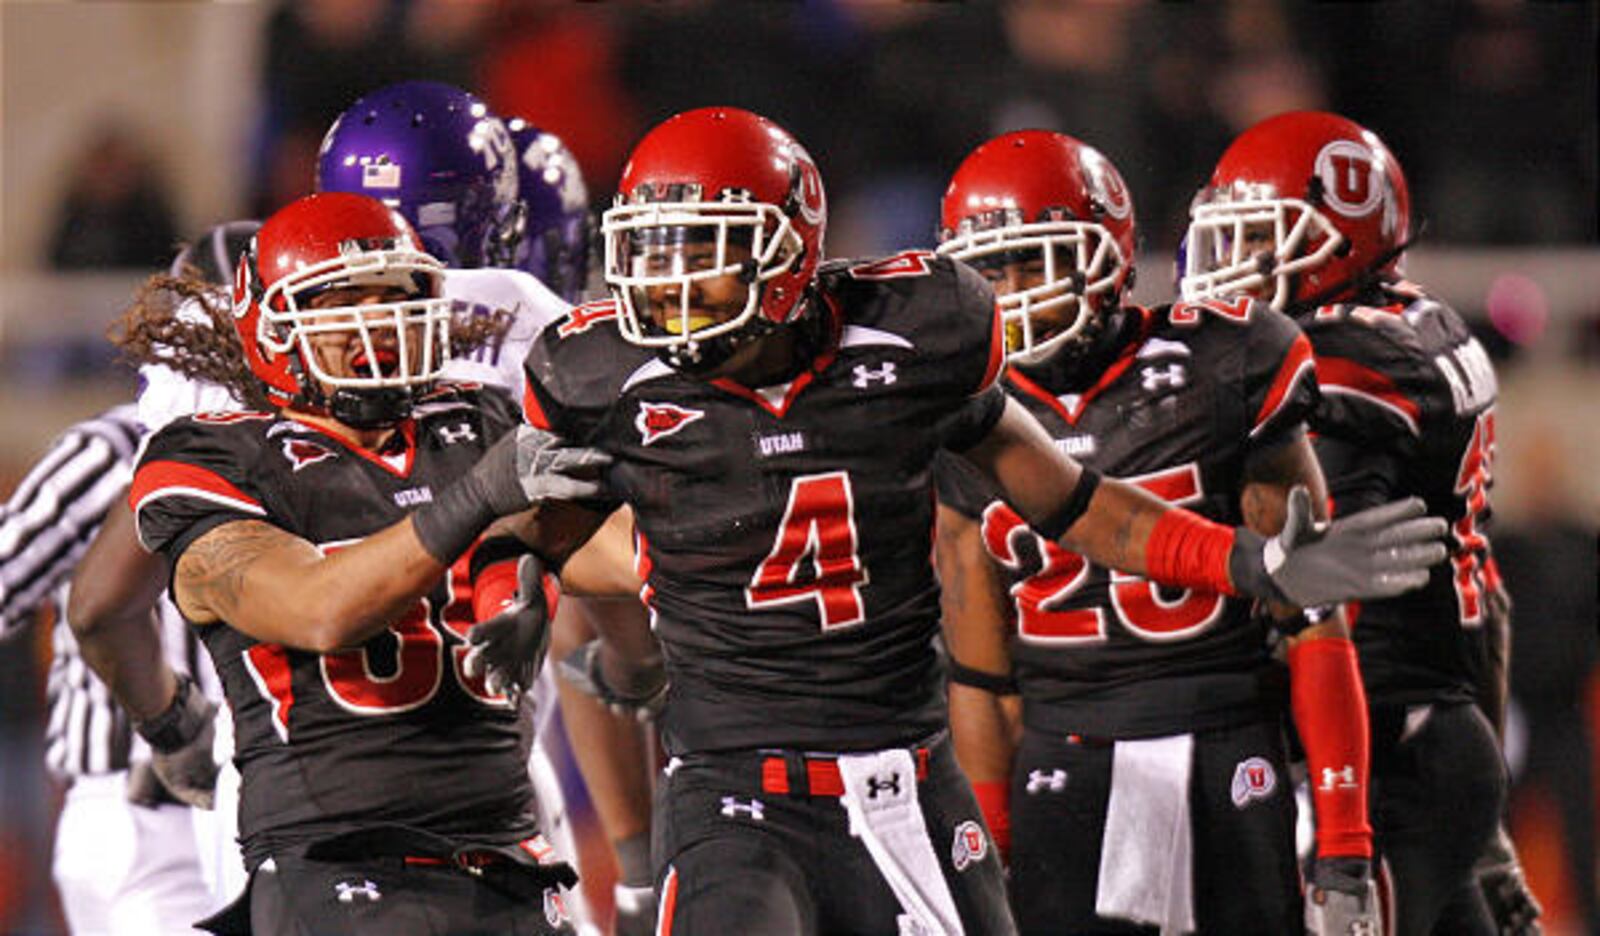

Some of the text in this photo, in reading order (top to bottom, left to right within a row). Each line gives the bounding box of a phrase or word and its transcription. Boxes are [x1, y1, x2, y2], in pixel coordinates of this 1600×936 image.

[1329, 154, 1371, 204] U
[760, 432, 803, 456] UTAH
[394, 486, 433, 506] UTAH
[744, 470, 870, 632] 4
